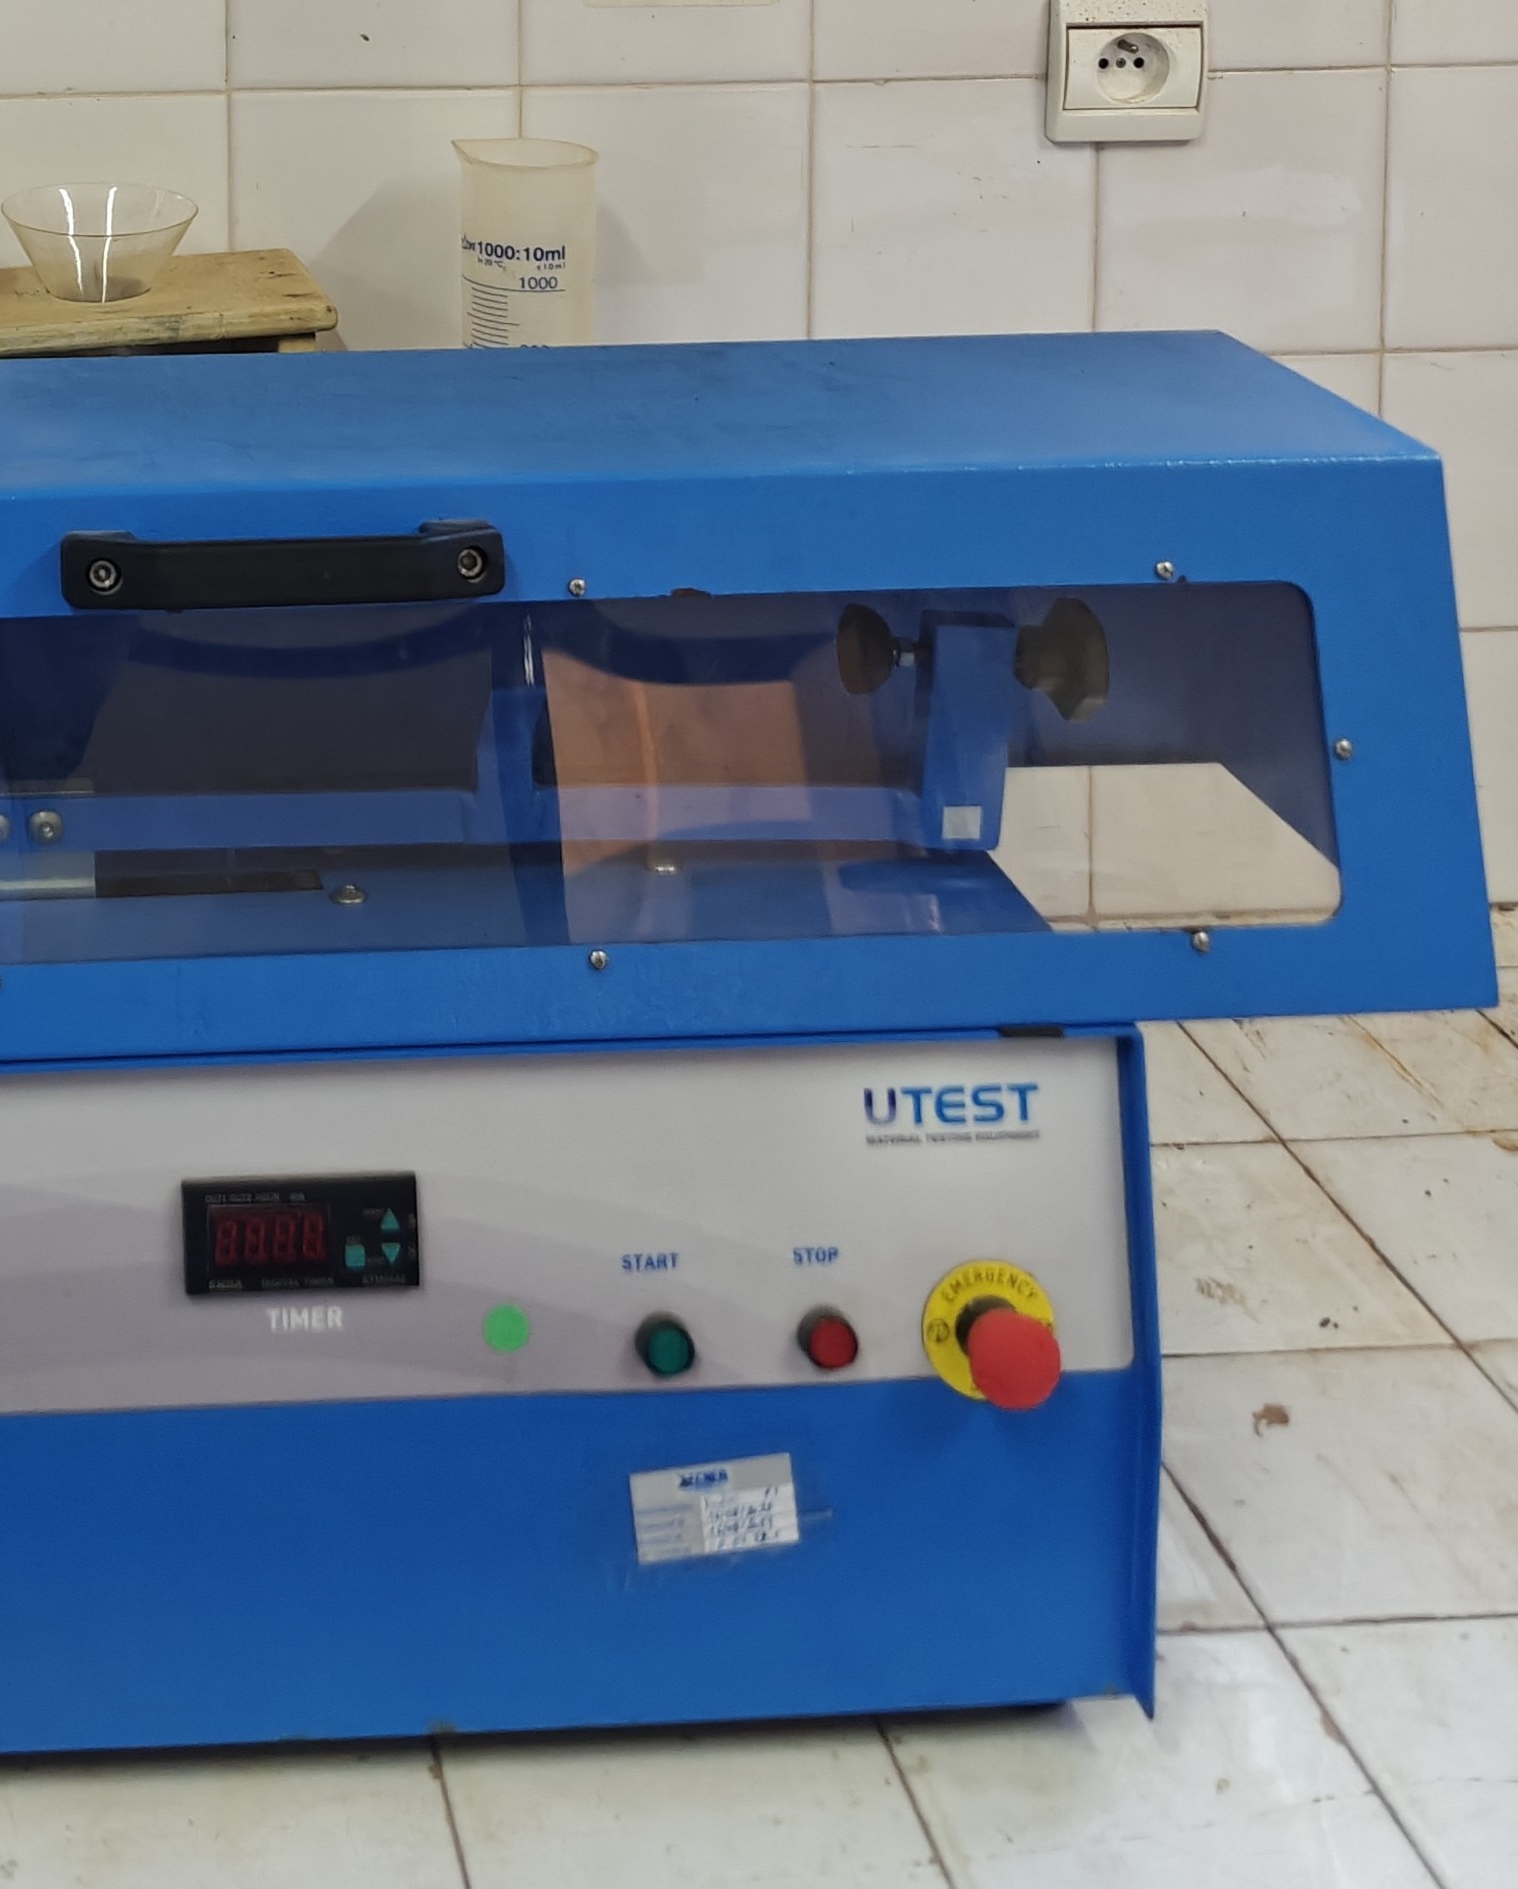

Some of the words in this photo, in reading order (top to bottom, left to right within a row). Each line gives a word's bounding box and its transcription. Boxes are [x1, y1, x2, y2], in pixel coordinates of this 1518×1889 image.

[519, 276, 558, 290] 1000
[864, 1082, 1039, 1125] UTEST
[622, 1252, 679, 1272] START
[793, 1246, 839, 1266] STOP
[941, 1267, 1039, 1304] EMERGENCY
[267, 1305, 344, 1332] TIMER
